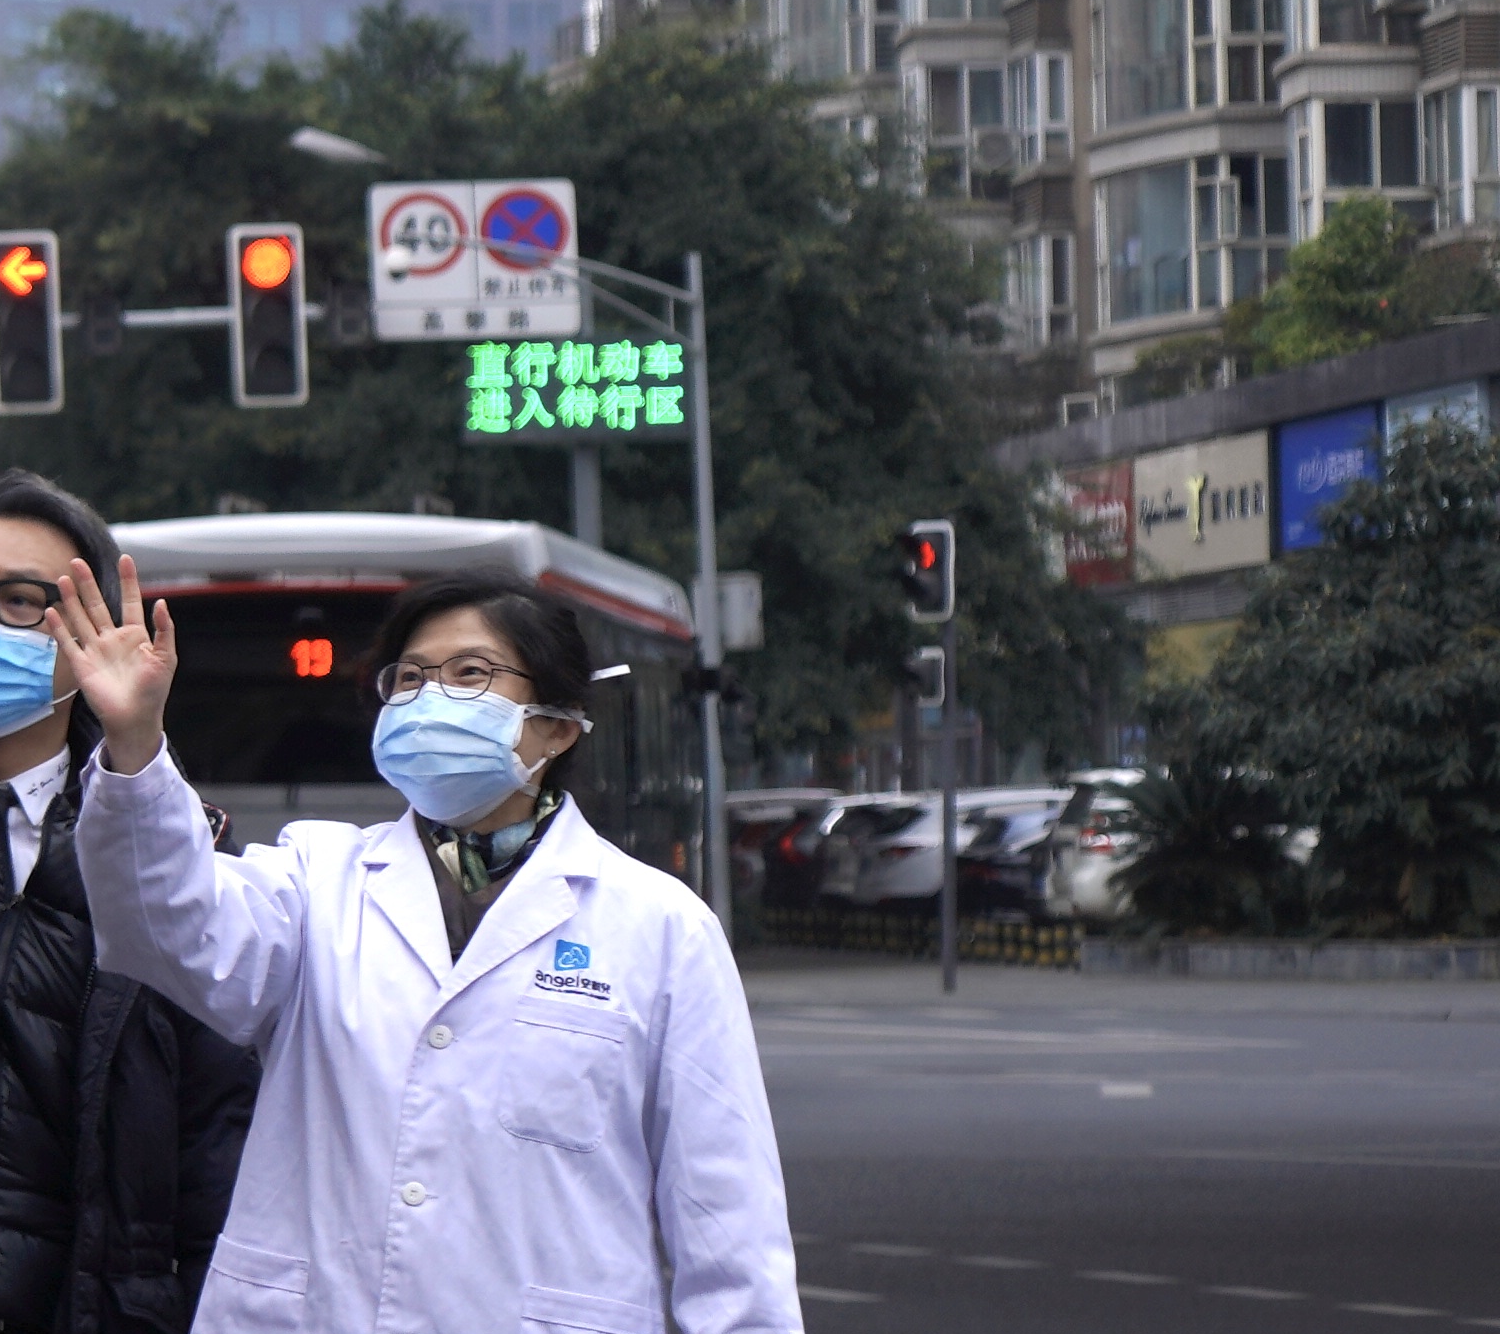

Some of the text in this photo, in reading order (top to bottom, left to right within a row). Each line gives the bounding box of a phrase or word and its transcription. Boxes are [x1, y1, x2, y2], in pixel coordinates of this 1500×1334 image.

[396, 216, 451, 253] 40
[465, 339, 685, 389] 直行机动车
[465, 384, 686, 434] 进入待行区
